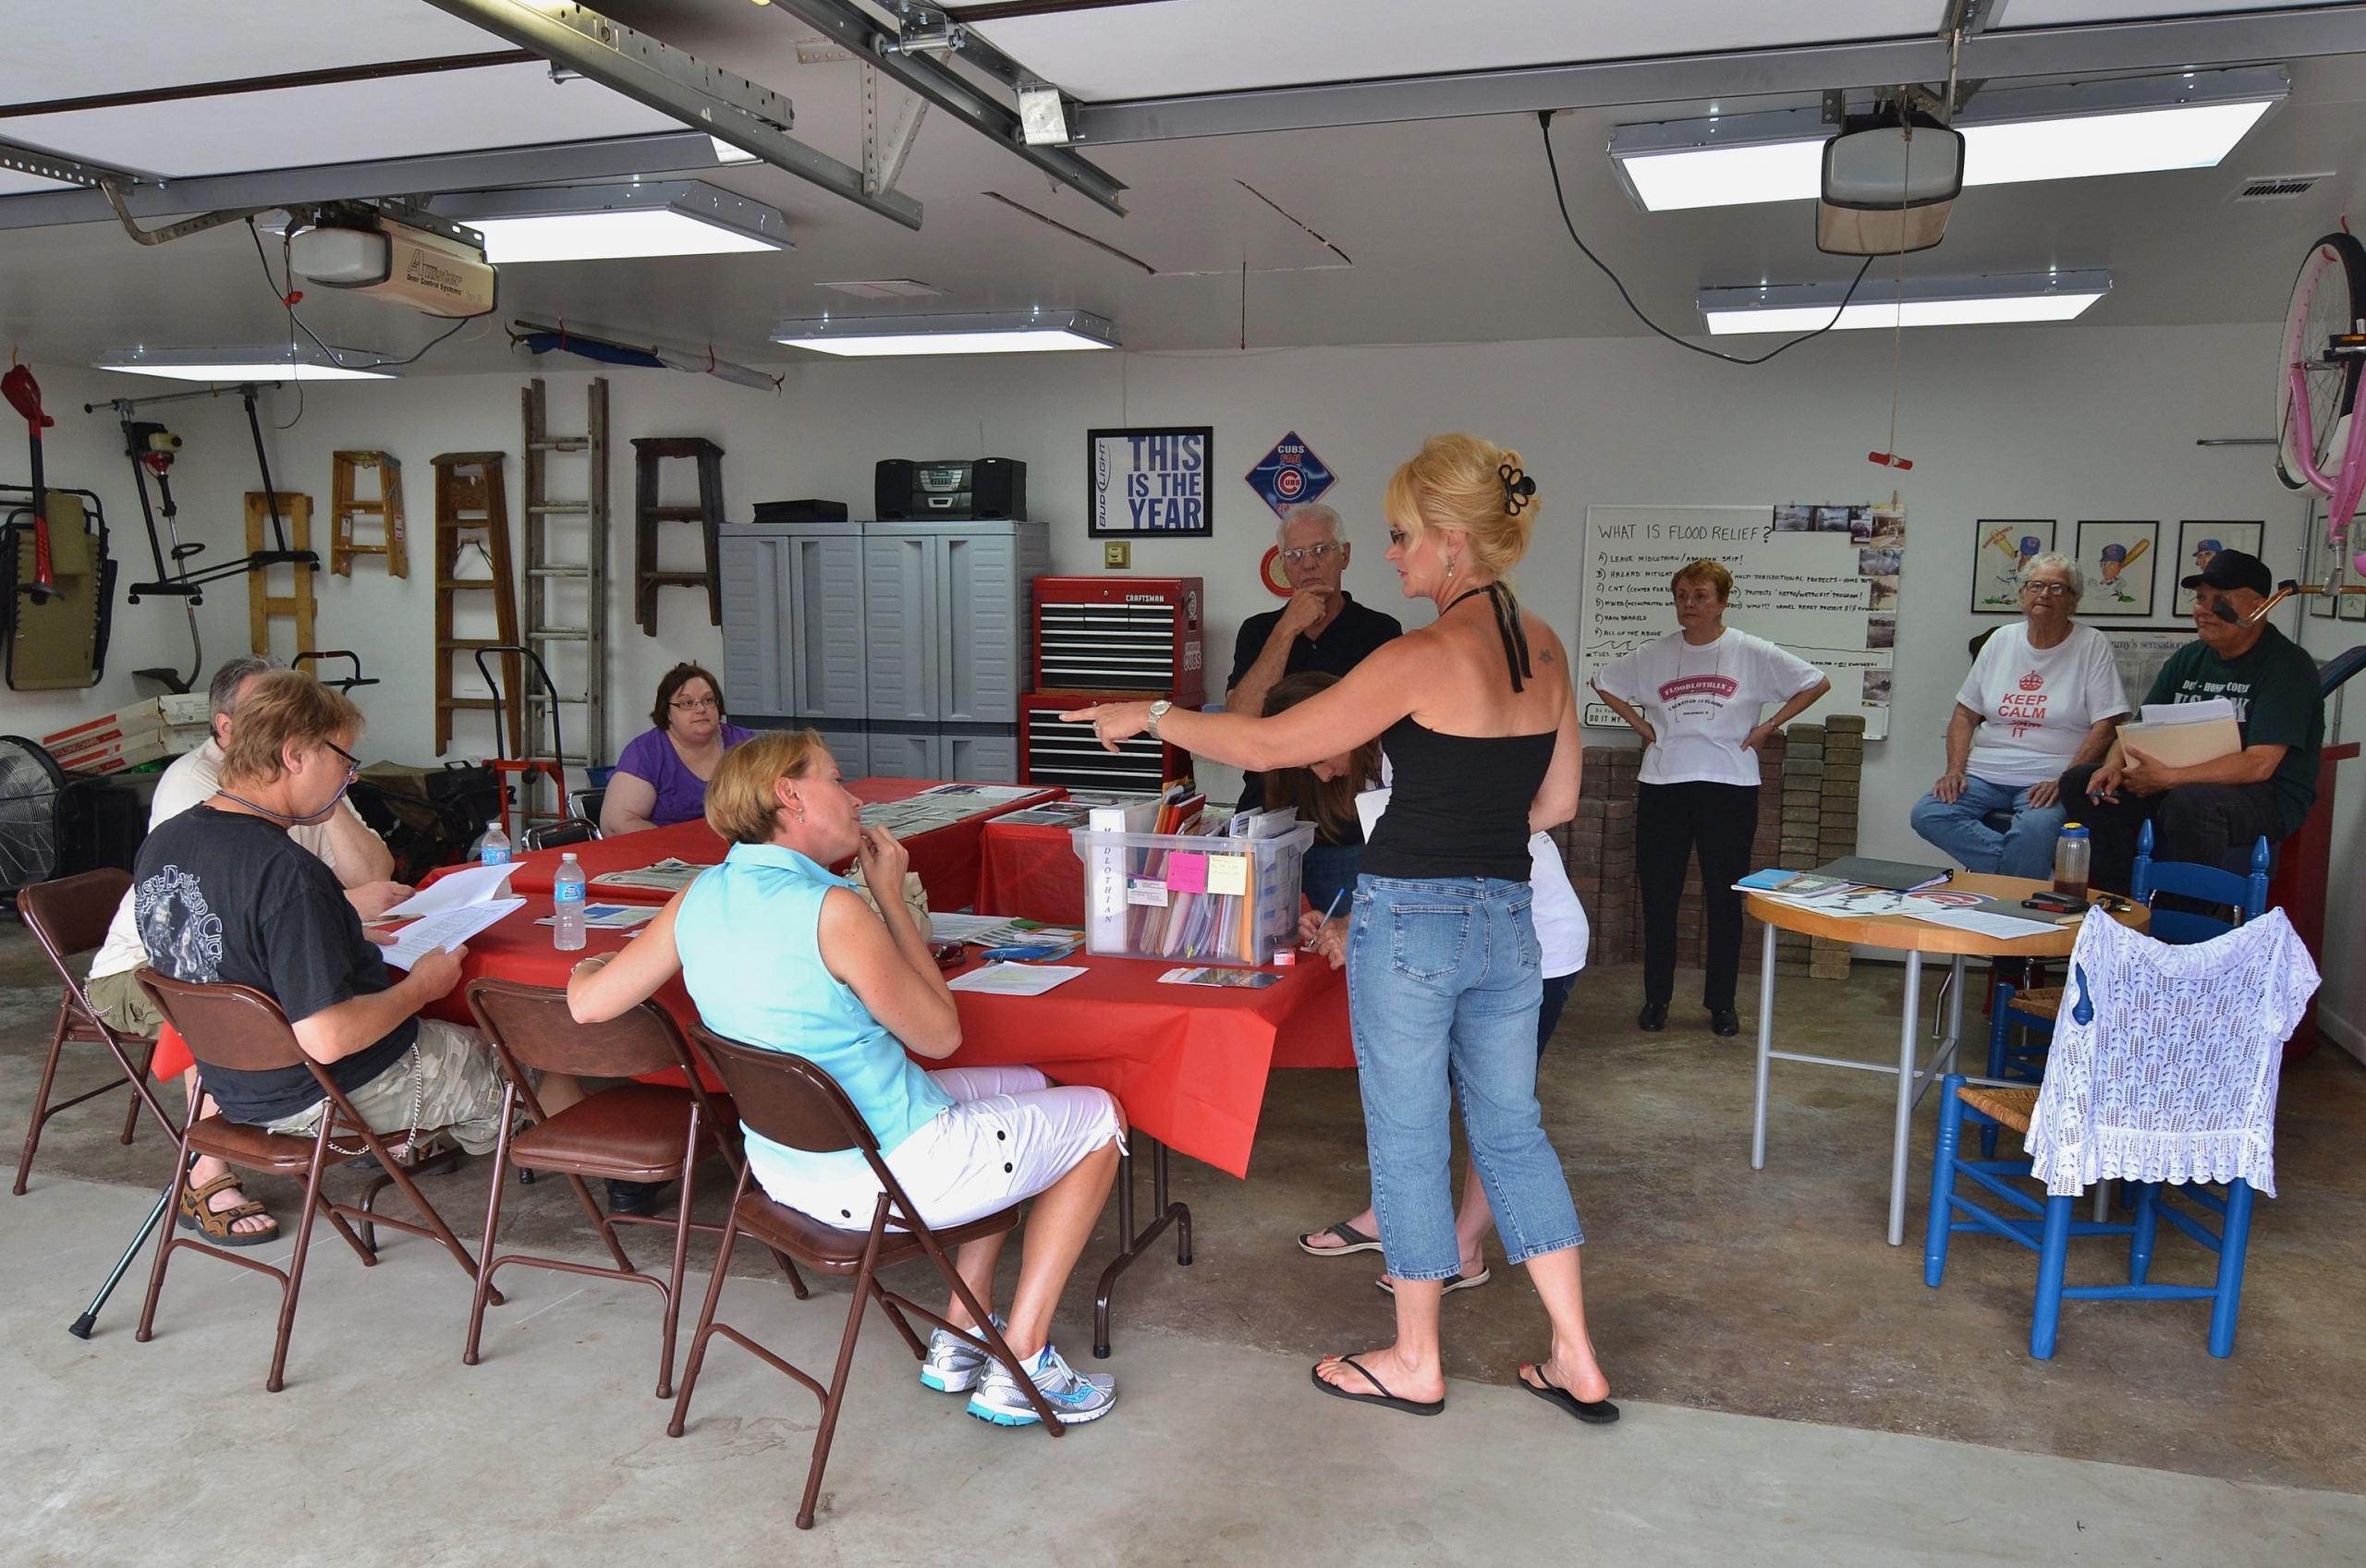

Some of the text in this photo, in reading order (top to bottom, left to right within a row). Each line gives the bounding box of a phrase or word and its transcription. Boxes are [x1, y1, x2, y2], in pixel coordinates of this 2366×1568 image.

[408, 273, 462, 296] Door Control Systems
[1128, 435, 1201, 471] THIS
[1277, 445, 1305, 454] CUBS
[1280, 455, 1301, 463] FAN
[1128, 472, 1201, 497] IS THE
[1128, 497, 1201, 529] YEAR
[1598, 524, 1636, 540] WHAT
[1647, 524, 1660, 539] IS
[1669, 526, 1707, 540] FLOOD
[1126, 594, 1165, 602] CRAFTSMAN
[1184, 650, 1201, 671] CUBS
[1665, 682, 1726, 696] FLOODLOTHIAN
[2002, 694, 2047, 705] KEEP
[1998, 706, 2046, 718] CALM
[2012, 727, 2028, 737] IT
[1104, 828, 1113, 923] MDLOTHIAN
